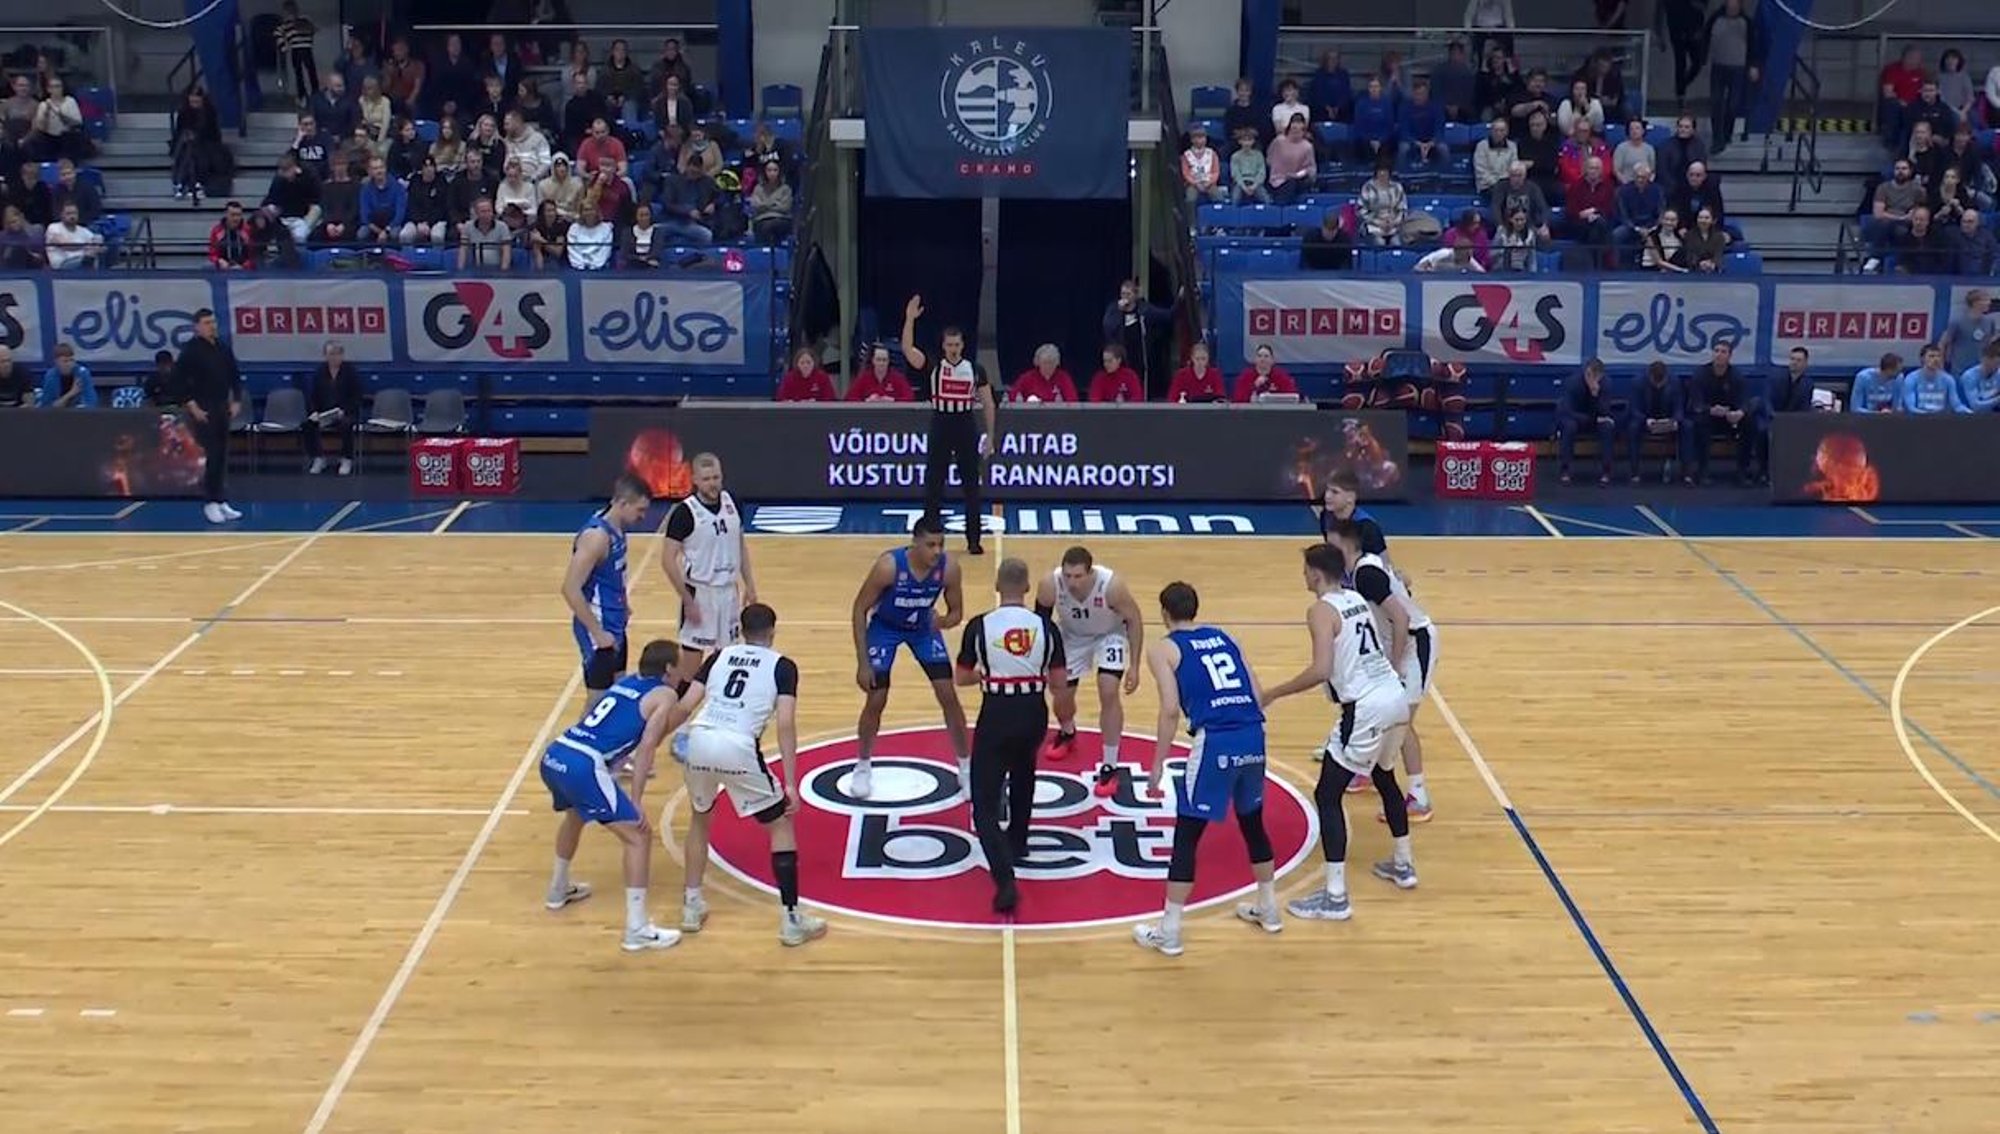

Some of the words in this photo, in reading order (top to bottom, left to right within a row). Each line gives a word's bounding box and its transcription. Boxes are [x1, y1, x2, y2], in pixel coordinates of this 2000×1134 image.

[299, 145, 325, 160] GAP
[959, 163, 1033, 174] CRAMO
[239, 310, 380, 331] CRAMO
[423, 282, 551, 358] G4S
[590, 291, 738, 352] elisa
[1253, 311, 1397, 332] CRAMO
[1440, 284, 1566, 361] G4S
[1603, 293, 1751, 353] elisa
[1781, 314, 1924, 336] CRAMO
[1001, 433, 1078, 454] AITAB
[990, 463, 1175, 486] RANNAROOTSI
[712, 518, 728, 537] 14
[1071, 607, 1089, 619] 31
[1355, 617, 1381, 656] 21
[1106, 647, 1123, 663] 31
[1200, 652, 1242, 691] 12
[723, 668, 750, 699] 6
[583, 696, 617, 728] 9
